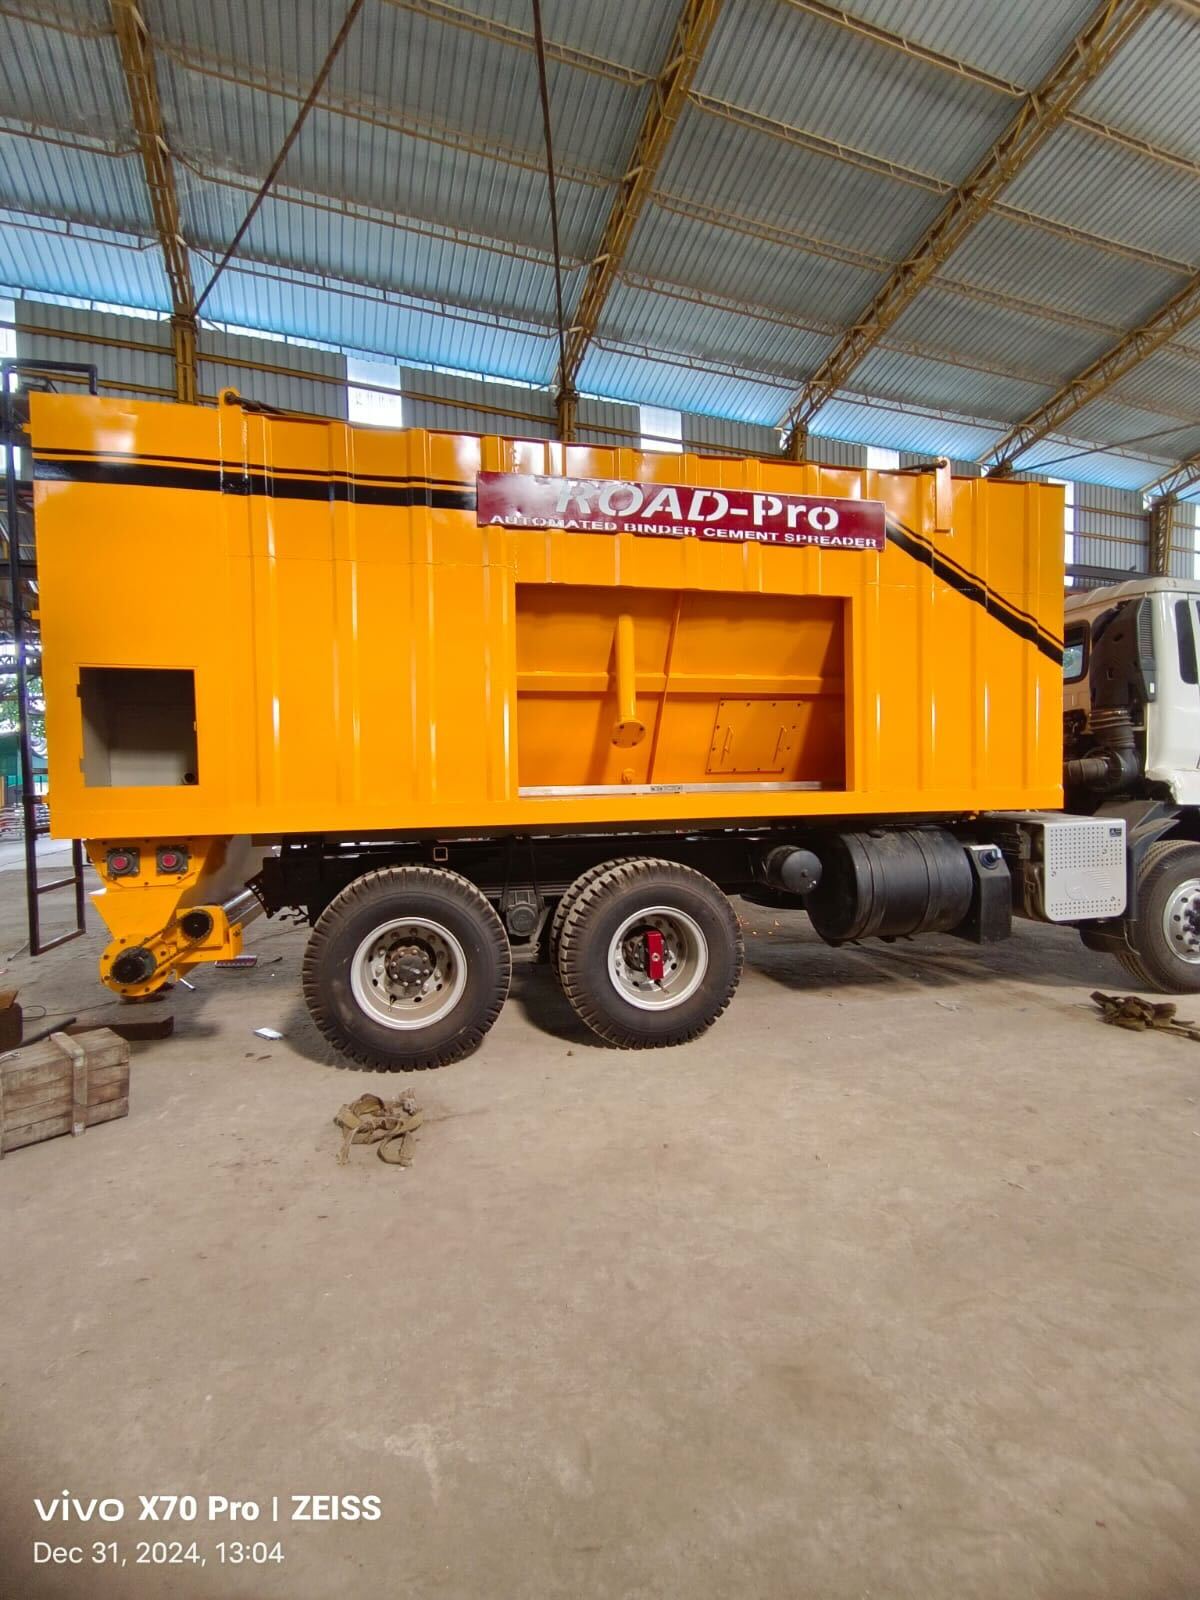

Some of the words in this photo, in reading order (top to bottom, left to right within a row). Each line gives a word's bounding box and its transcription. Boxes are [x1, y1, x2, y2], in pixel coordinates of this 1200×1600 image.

[556, 481, 839, 531] ROAD-Pro
[489, 514, 617, 531] AUTOMATED
[623, 522, 697, 537] BINDER
[703, 527, 779, 542] CEMENT
[784, 532, 877, 548] SPREADER
